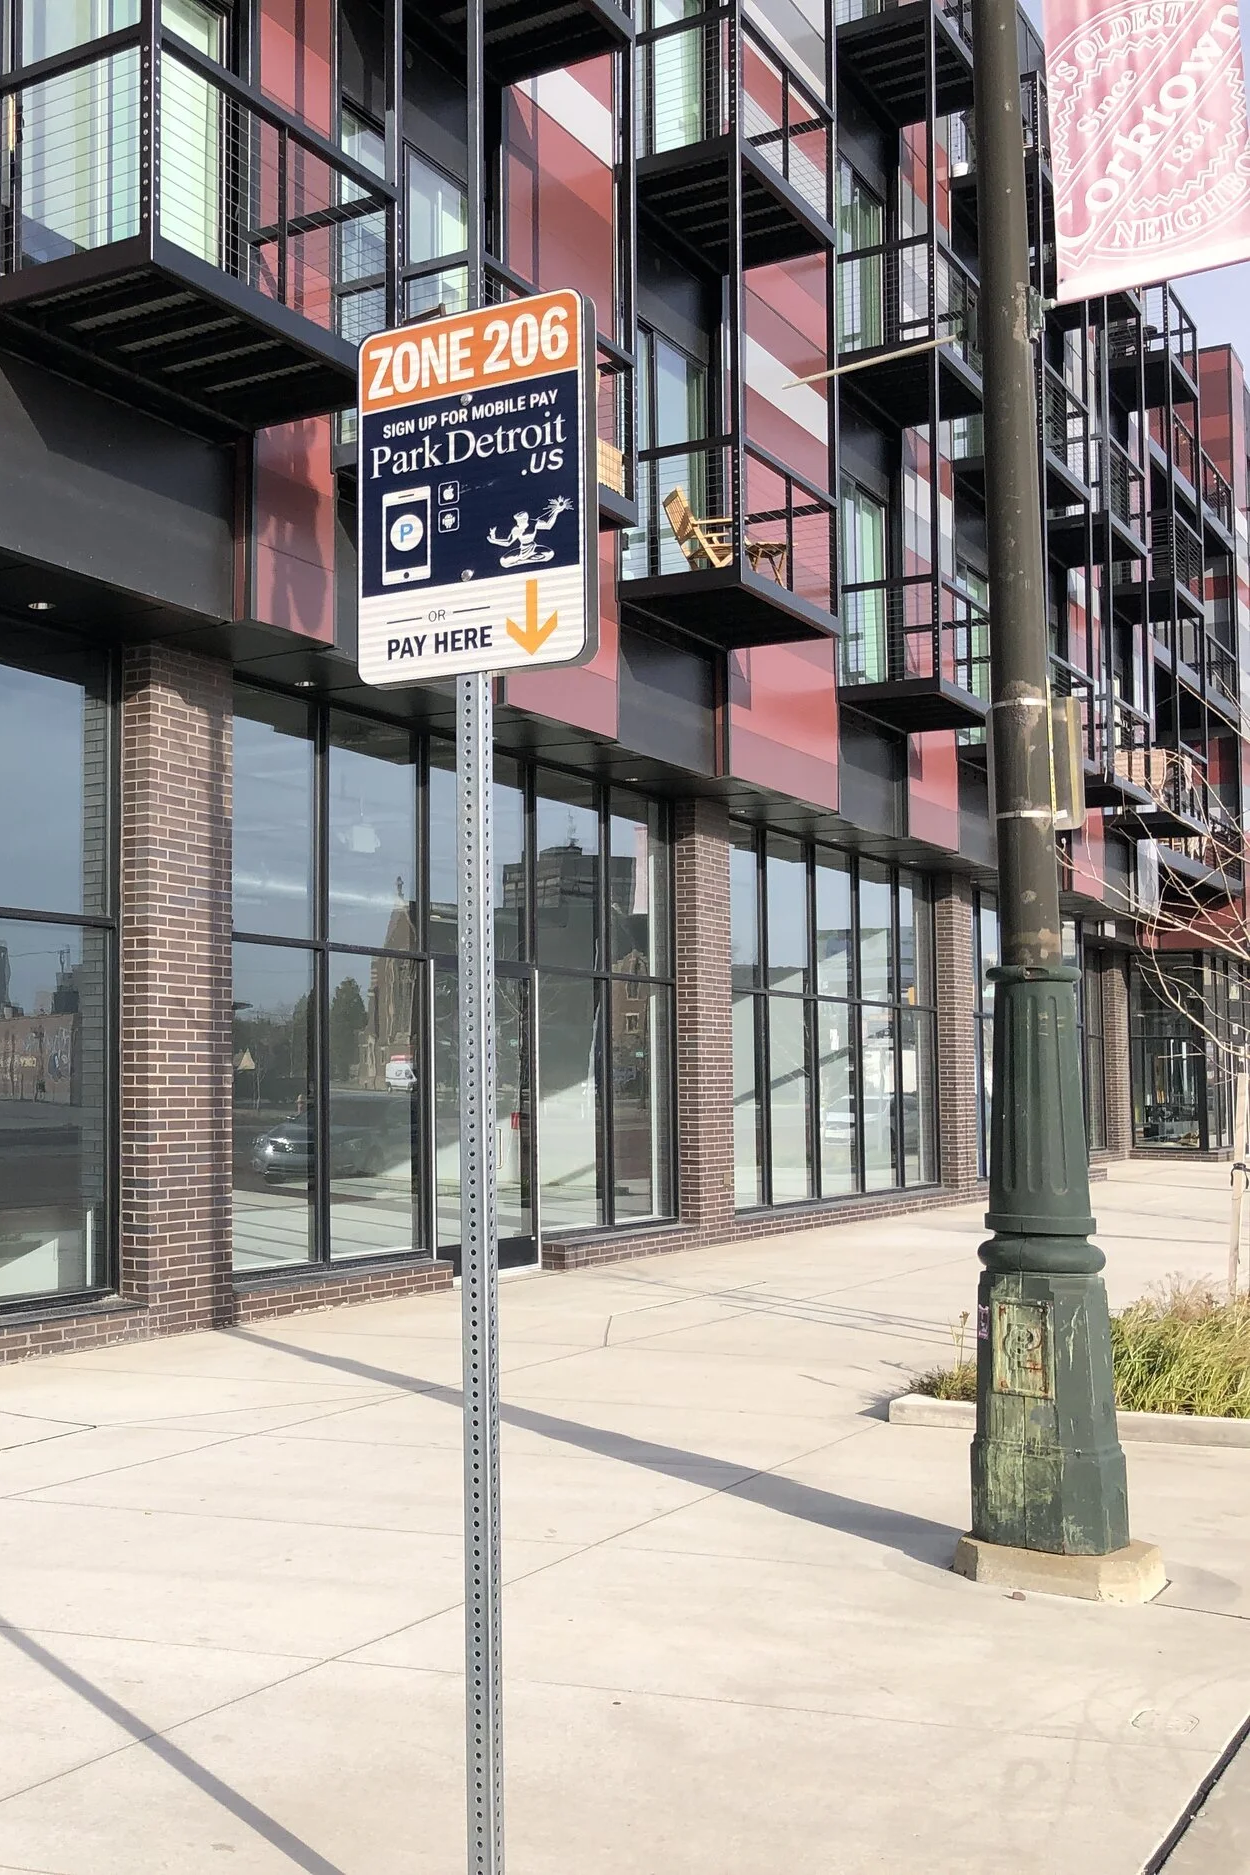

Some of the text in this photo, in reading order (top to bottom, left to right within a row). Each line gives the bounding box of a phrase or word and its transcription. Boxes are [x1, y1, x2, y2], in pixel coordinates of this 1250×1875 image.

[1074, 2, 1185, 62] OLDEST
[1077, 68, 1138, 135] Since
[1161, 116, 1217, 177] 1834
[368, 305, 569, 400] ZONE 206
[382, 388, 559, 440] SIGN UP FOR MOBILE PAY
[521, 448, 565, 477] .US
[400, 521, 414, 543] P
[427, 608, 447, 623] OR
[387, 625, 493, 661] PAY HERE
